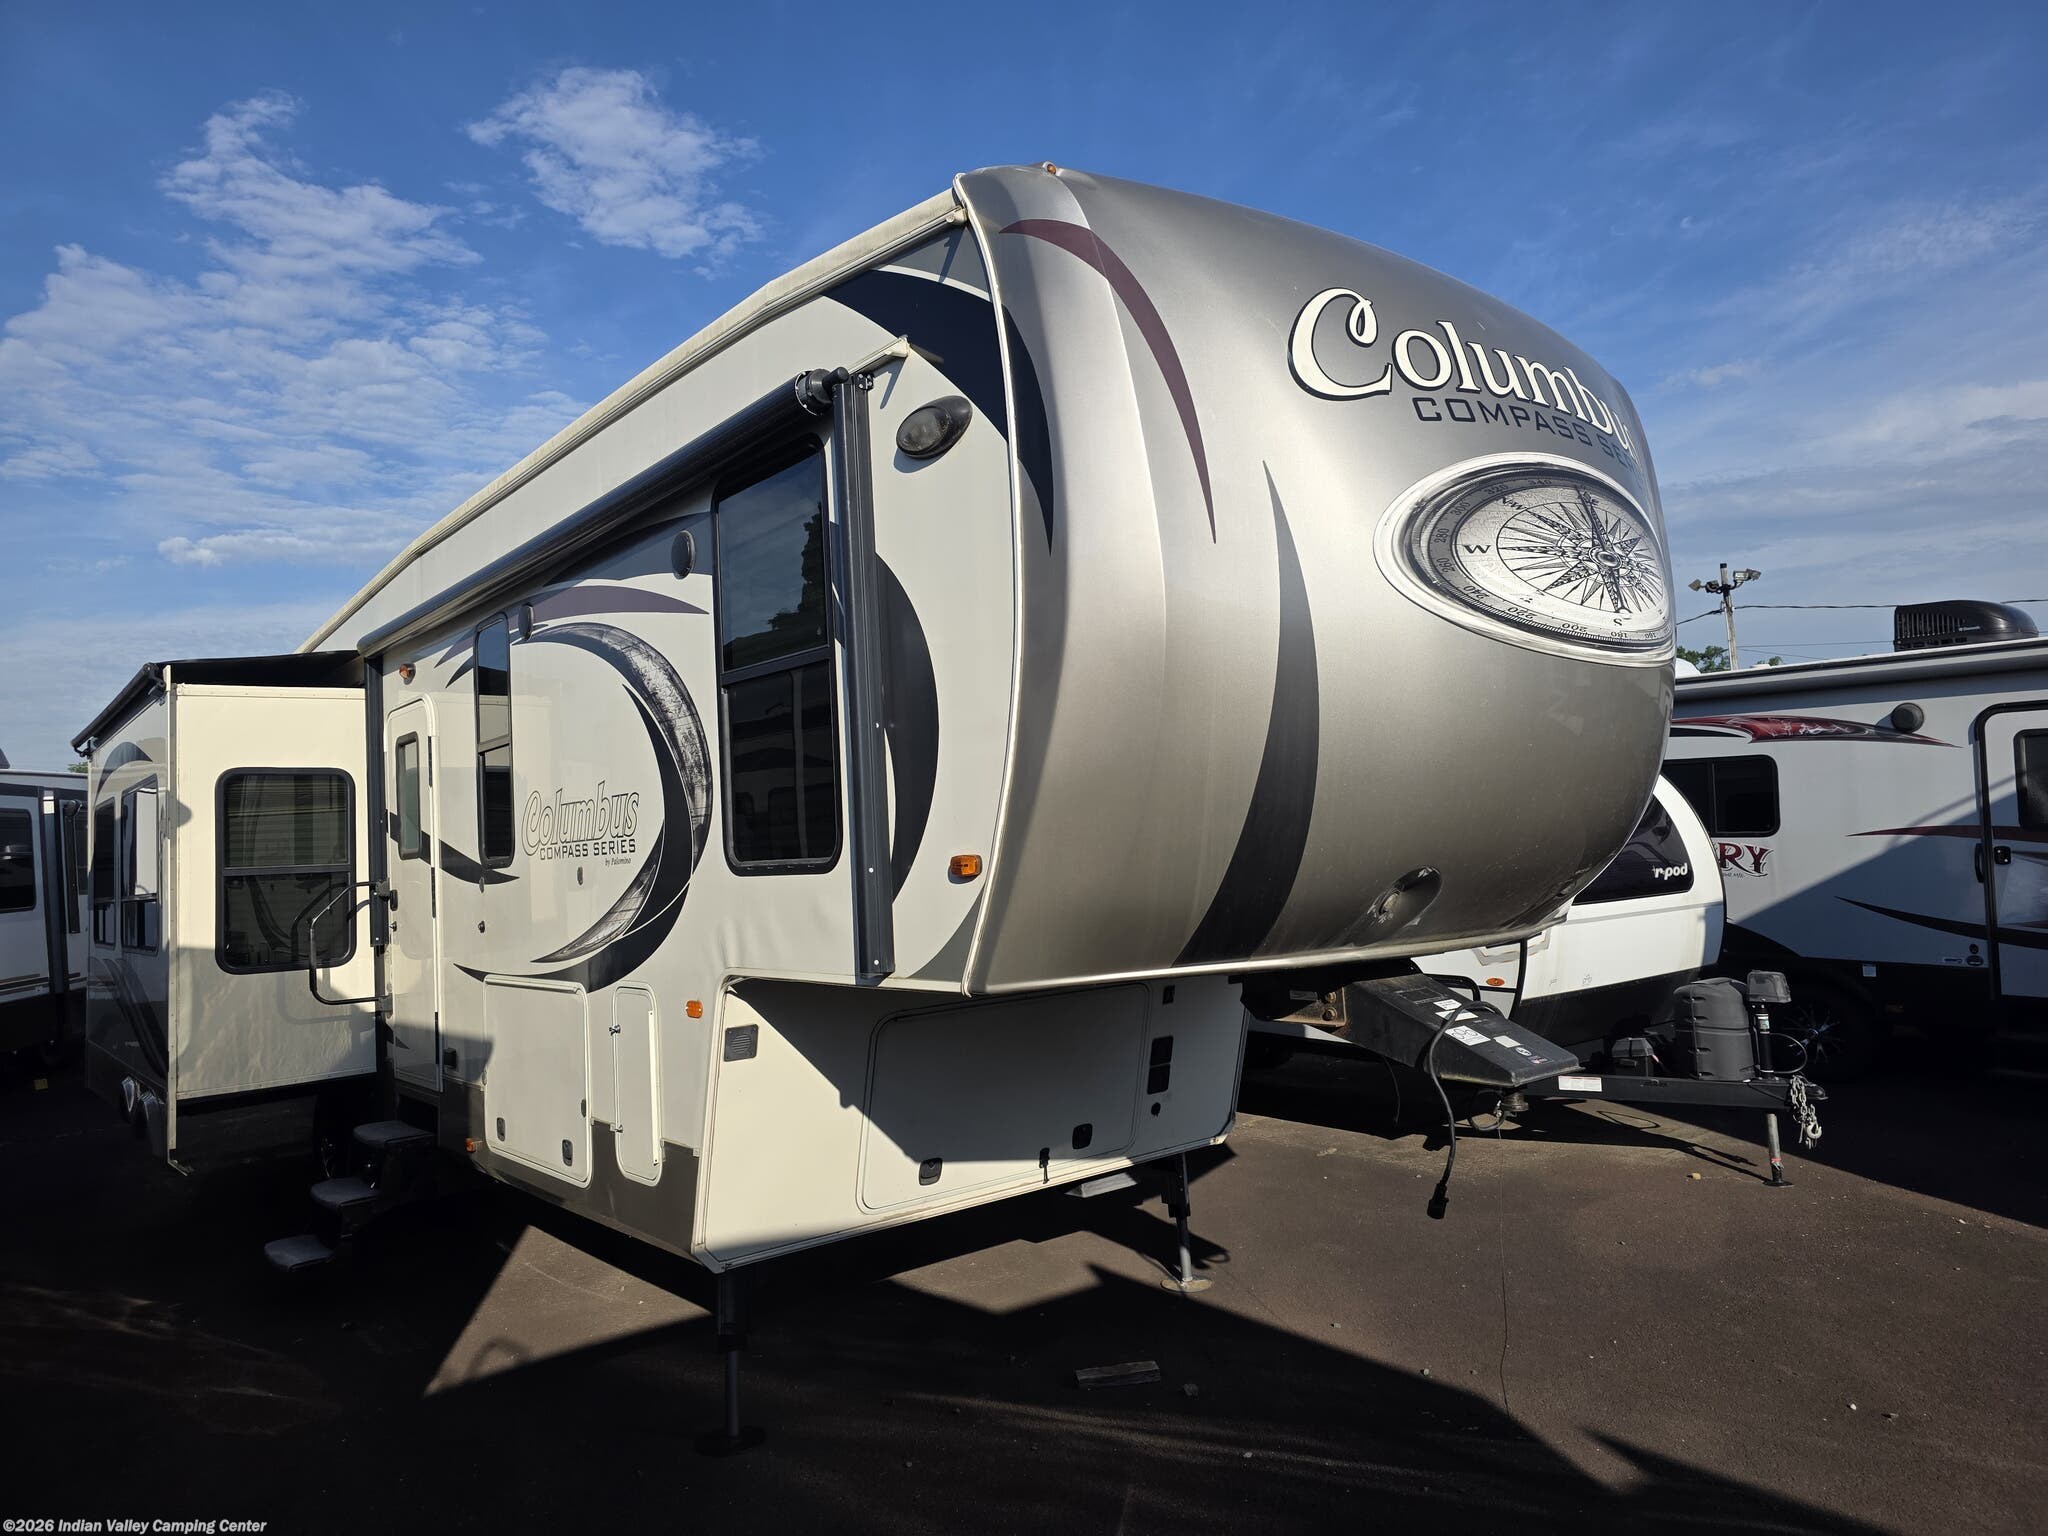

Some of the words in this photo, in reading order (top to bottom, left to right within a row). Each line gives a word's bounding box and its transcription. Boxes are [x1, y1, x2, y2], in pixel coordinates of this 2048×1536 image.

[1412, 396, 1593, 447] COMPASS
[1450, 501, 1471, 516] 300
[1434, 528, 1450, 543] 280
[1462, 544, 1492, 554] W
[1436, 558, 1455, 573] 260
[1463, 585, 1490, 600] 240
[1507, 606, 1538, 620] 220
[1561, 622, 1588, 633] 200
[521, 780, 640, 856] Columbus
[539, 841, 589, 860] COMPASS
[593, 838, 636, 856] SERIES
[605, 858, 610, 867] by
[611, 857, 632, 866] Palomino
[1714, 842, 1773, 877] RY
